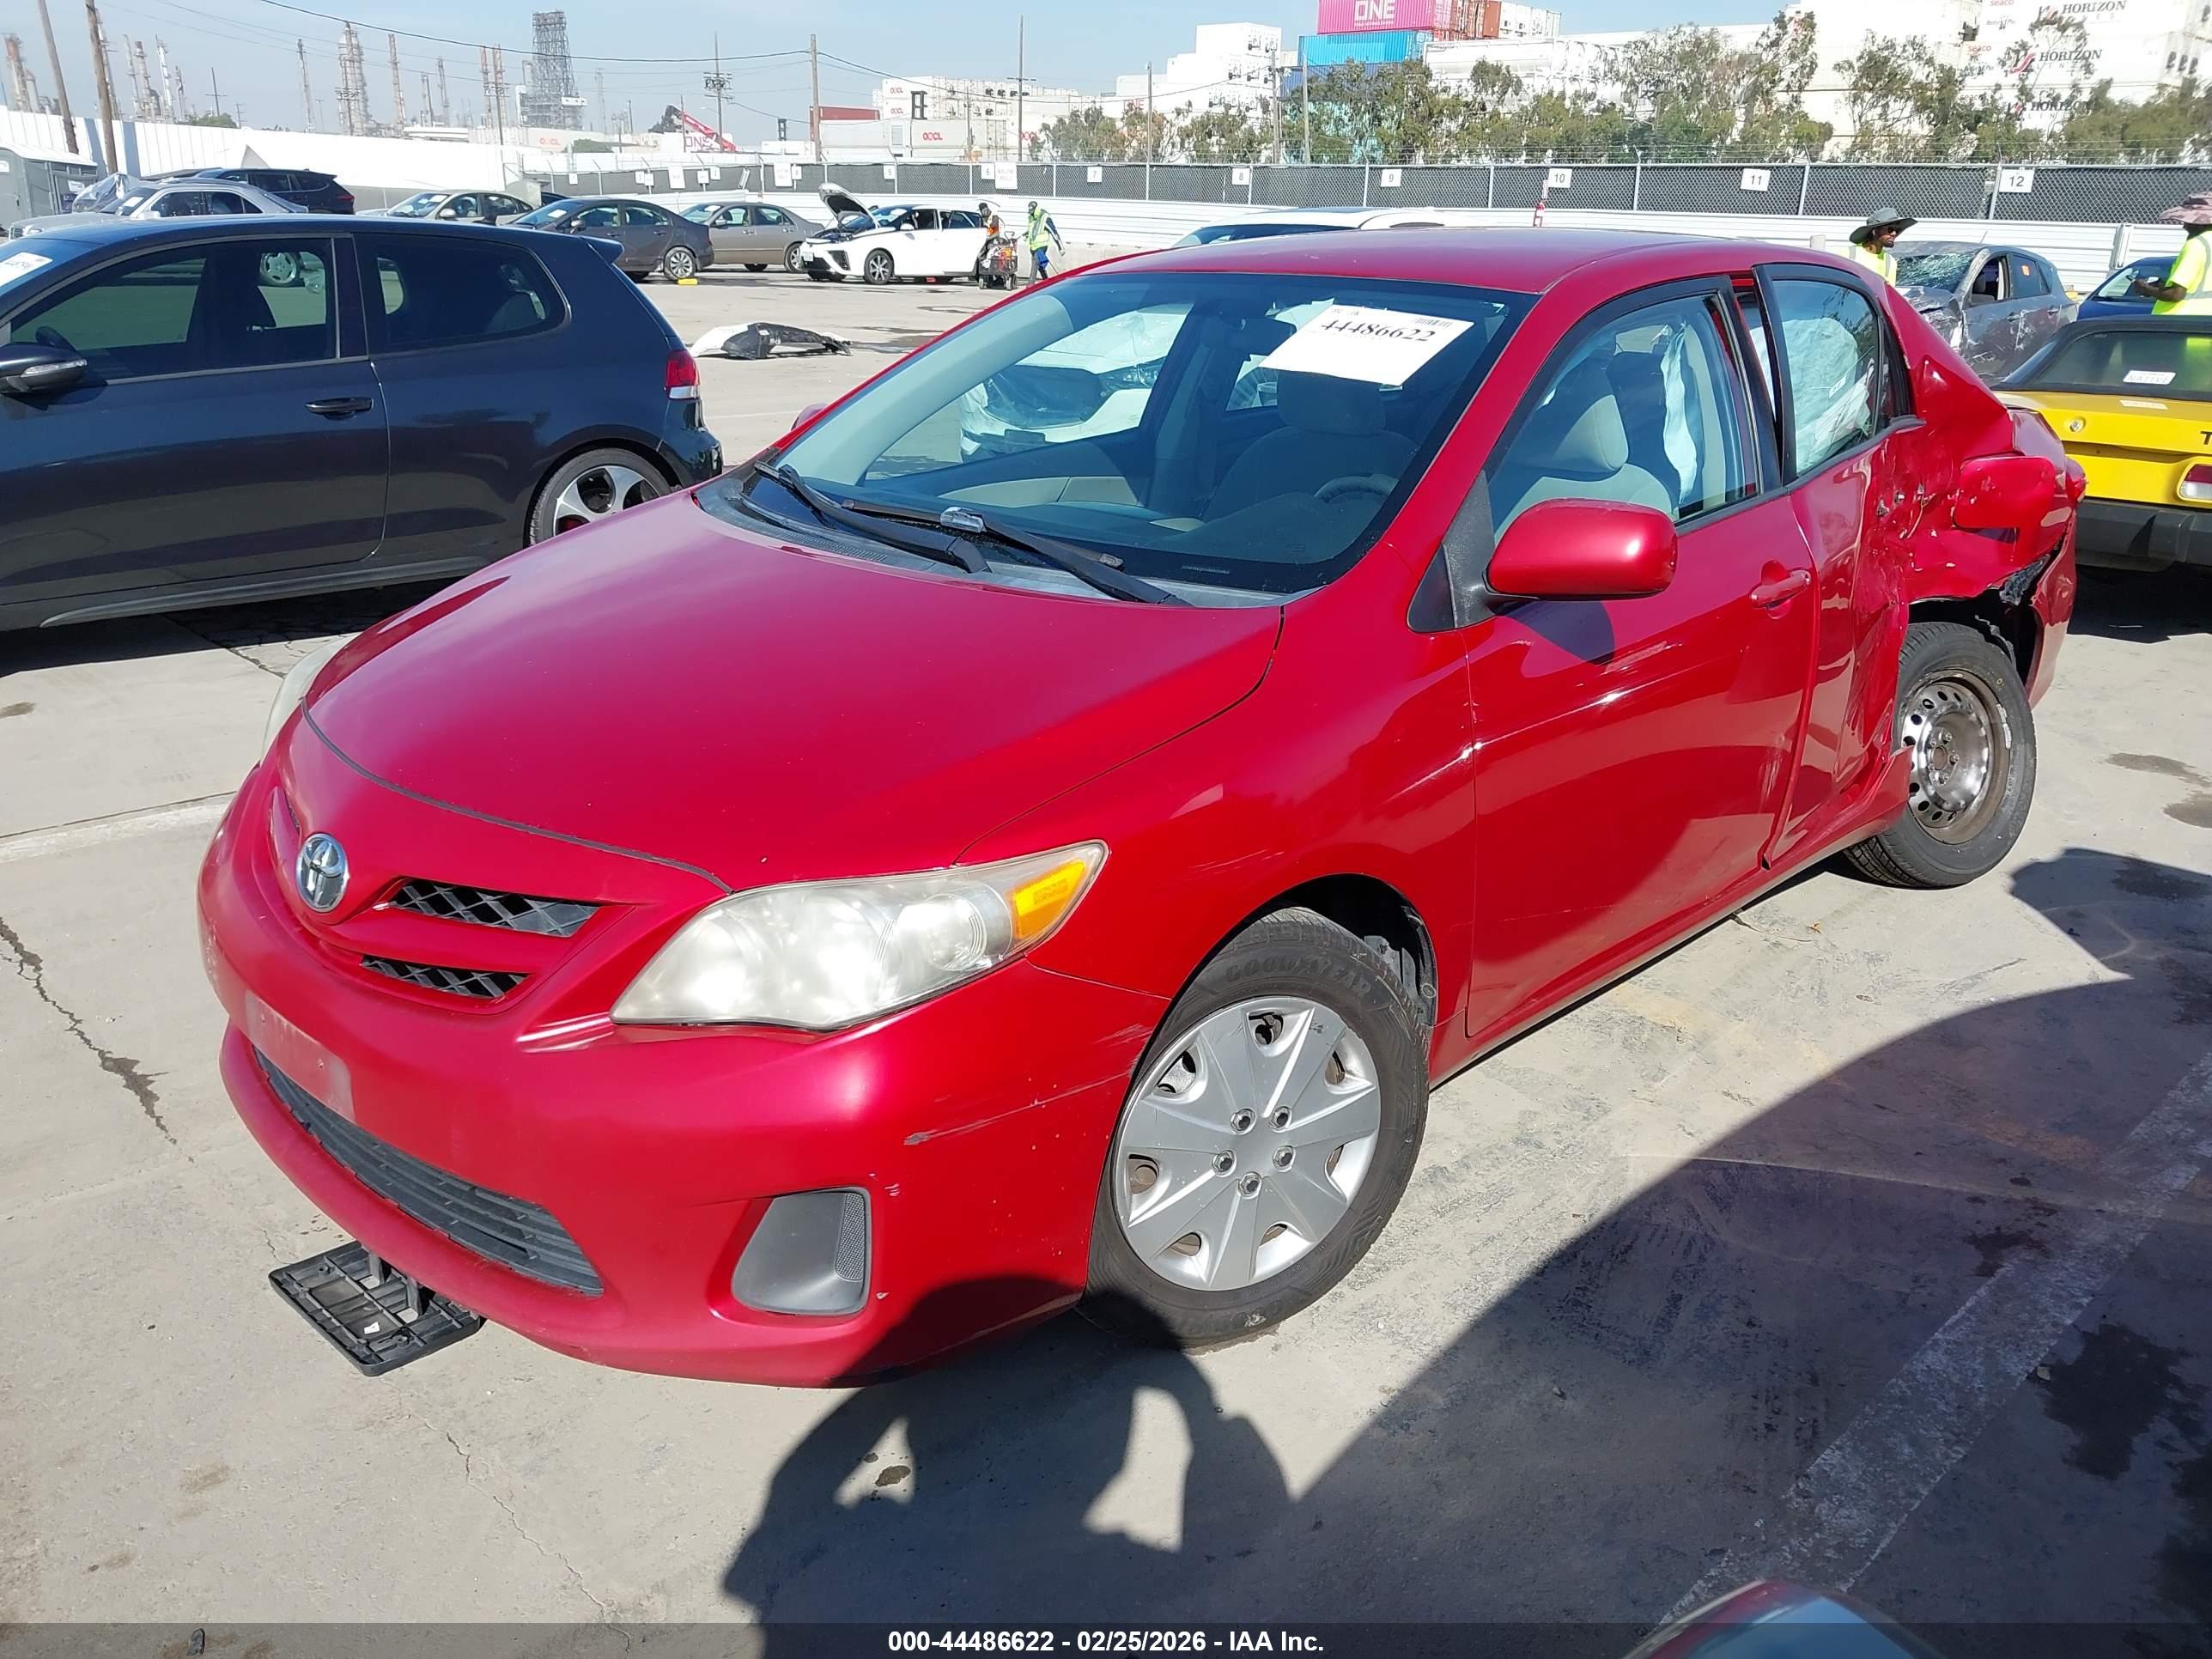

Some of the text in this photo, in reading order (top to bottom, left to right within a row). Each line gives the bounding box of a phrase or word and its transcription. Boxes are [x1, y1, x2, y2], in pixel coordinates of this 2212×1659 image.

[1354, 0, 1395, 21] ONE
[2062, 0, 2128, 14] HORIZON
[2039, 50, 2102, 61] HORIZON
[922, 132, 943, 141] OOCL
[1092, 170, 1097, 179] 7
[1238, 172, 1244, 181] 8
[1389, 173, 1395, 183] 9
[1554, 173, 1565, 183] 10
[1750, 174, 1763, 185] 11
[2009, 176, 2025, 186] 12
[1321, 319, 1437, 342] 44486622
